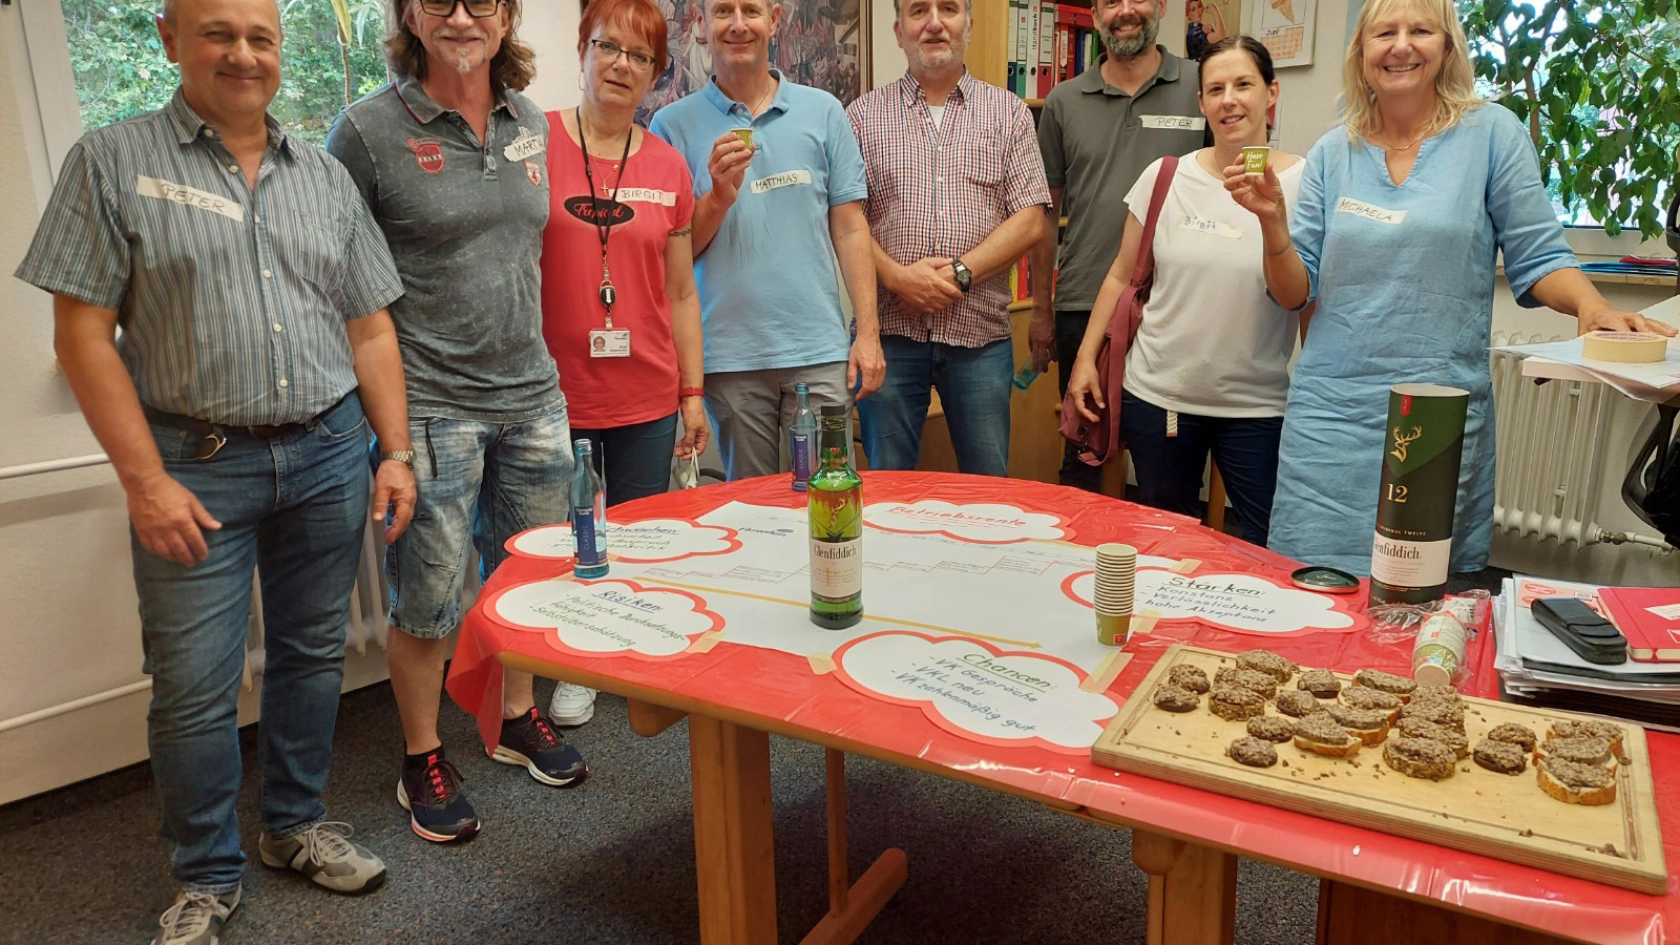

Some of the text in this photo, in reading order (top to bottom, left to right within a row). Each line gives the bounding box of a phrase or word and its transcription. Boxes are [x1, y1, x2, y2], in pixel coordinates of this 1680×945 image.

[1156, 117, 1193, 128] PETER
[1246, 151, 1264, 160] Have
[1246, 160, 1263, 170] Fun!
[755, 173, 798, 191] MATTHIAS
[160, 183, 225, 213] PETER
[620, 189, 664, 201] BIRGIT
[1339, 198, 1392, 221] MICHAELA
[1387, 483, 1408, 503] 12
[886, 505, 1027, 527] Betriebsrente
[814, 544, 857, 560] Glenfiddich
[951, 681, 986, 696] neu
[1001, 718, 1036, 731] gut
